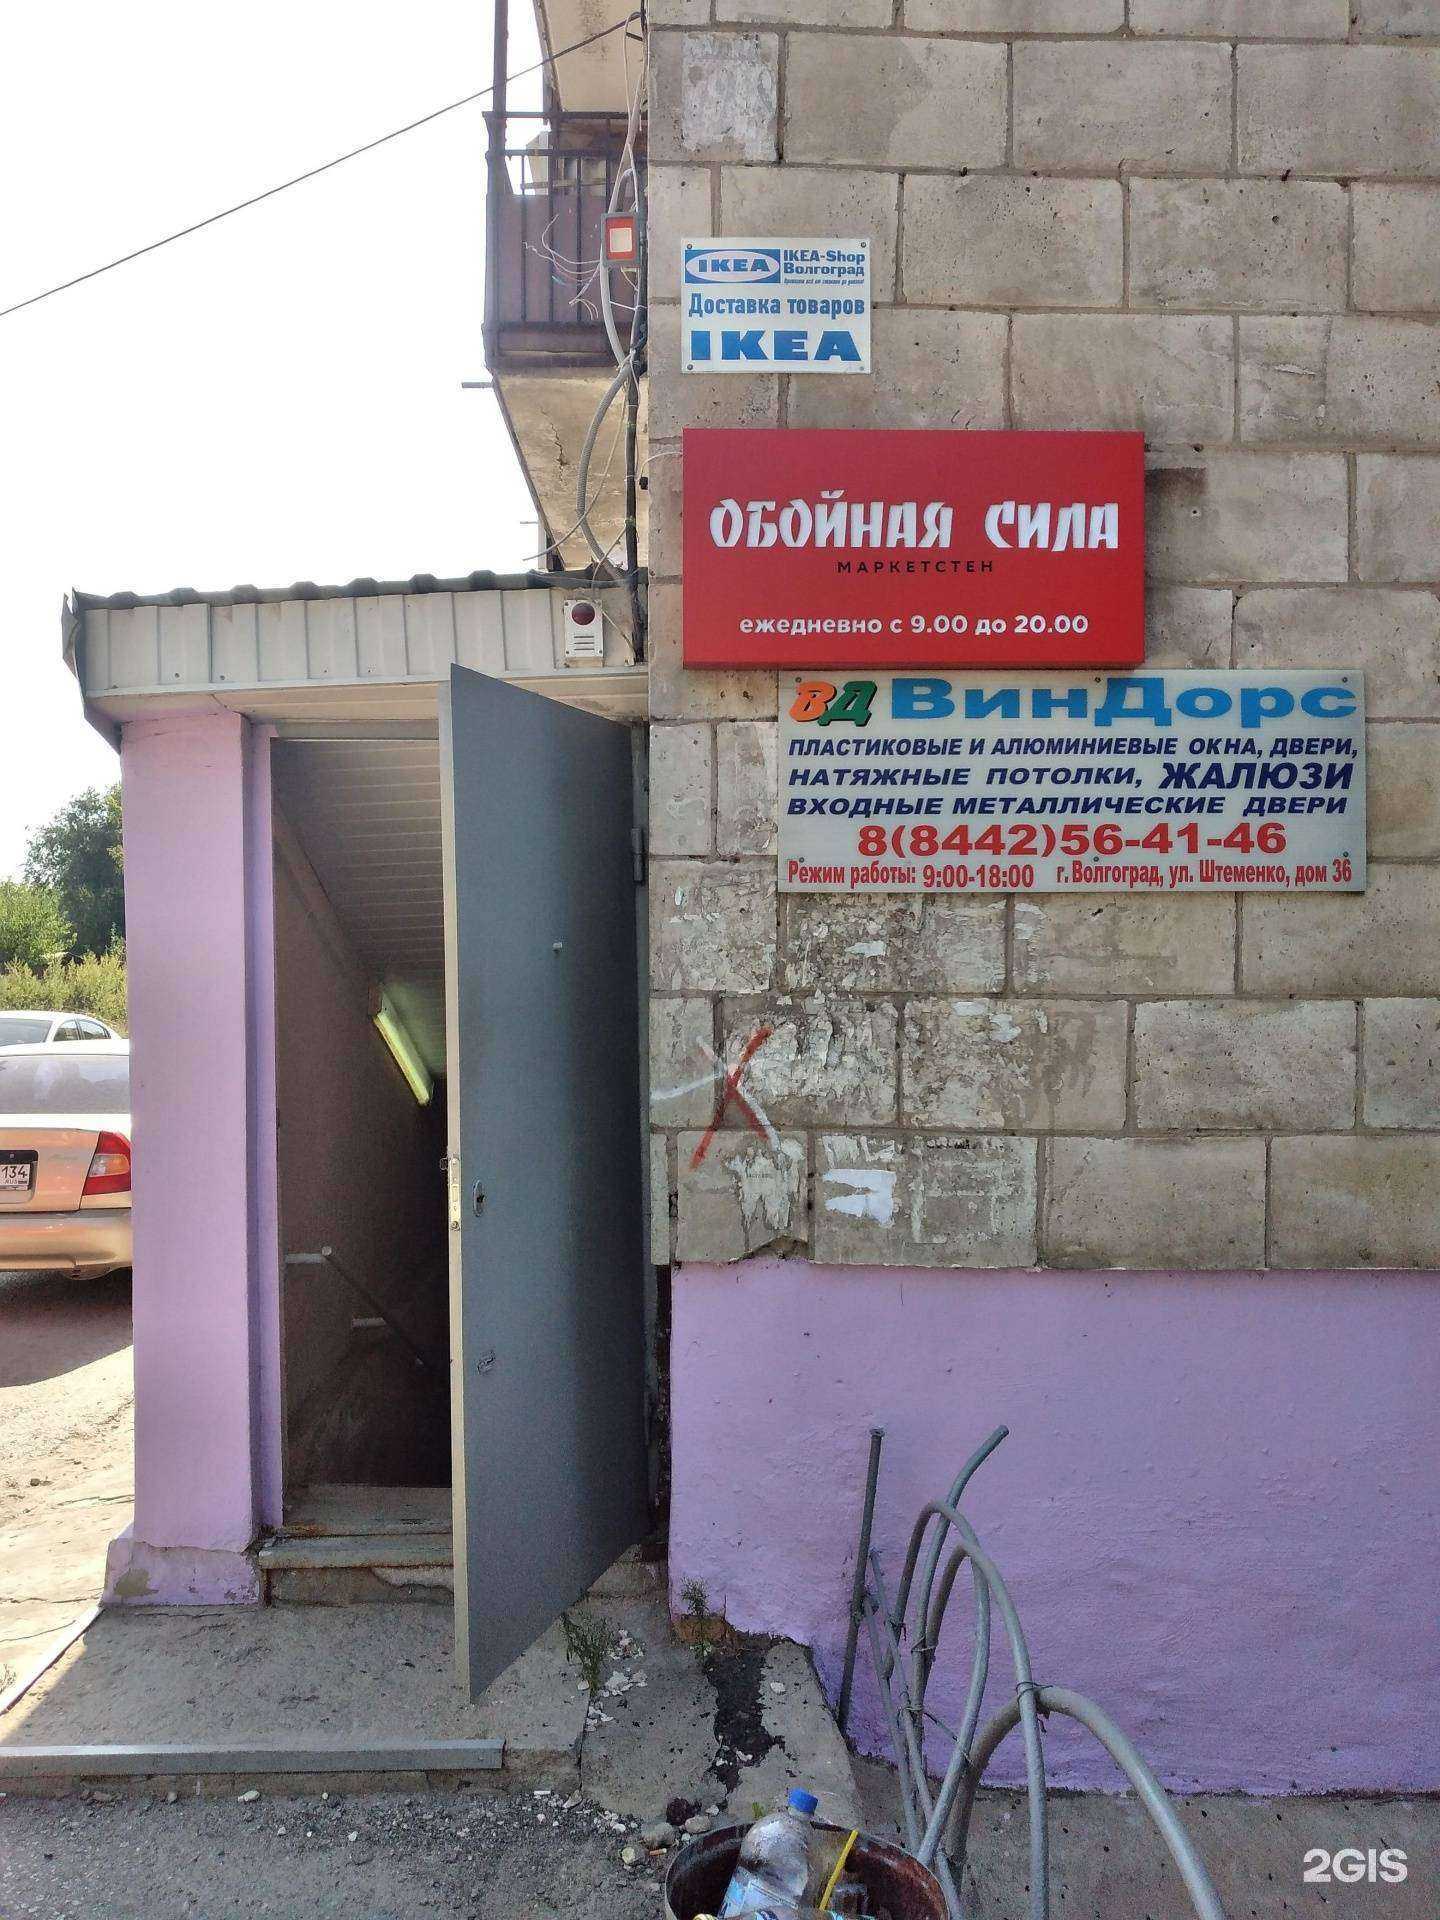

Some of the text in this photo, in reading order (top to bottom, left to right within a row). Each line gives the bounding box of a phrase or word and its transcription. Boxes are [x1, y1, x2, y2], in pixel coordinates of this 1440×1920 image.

[698, 258, 771, 273] IKEA
[783, 250, 866, 267] IKEA-Shop
[783, 262, 865, 277] Волгоград
[688, 293, 865, 319] Доставка товаров
[691, 330, 862, 362] IKEA
[709, 489, 1119, 552] ОБОЙНАЯ СИЛА
[837, 560, 994, 573] МАРКЕТСТЕН
[739, 614, 1089, 638] ежедневно с 9.00 до 20.00
[788, 680, 878, 726] ВД
[788, 737, 1358, 759] ПЛАСТИКОВЫЕ И АЛЮМИНИЕВЫЕ ОКНА, ДВЕРИ,
[788, 762, 1354, 789] НАТЯЖНЫЕ ПОТОЛКИ, ЖАЛЮЗИ
[787, 796, 1348, 818] ВХОДНЫЕ МЕТАЛЛИЧЕСКИЕ ДВЕРИ
[857, 822, 1287, 859] 8(8442)56-41-46
[788, 858, 1352, 889] Режим работы: 9:00-18:00 г. Волгоград, ул. Штеменко, дом 36
[2, 1166, 28, 1178] 134
